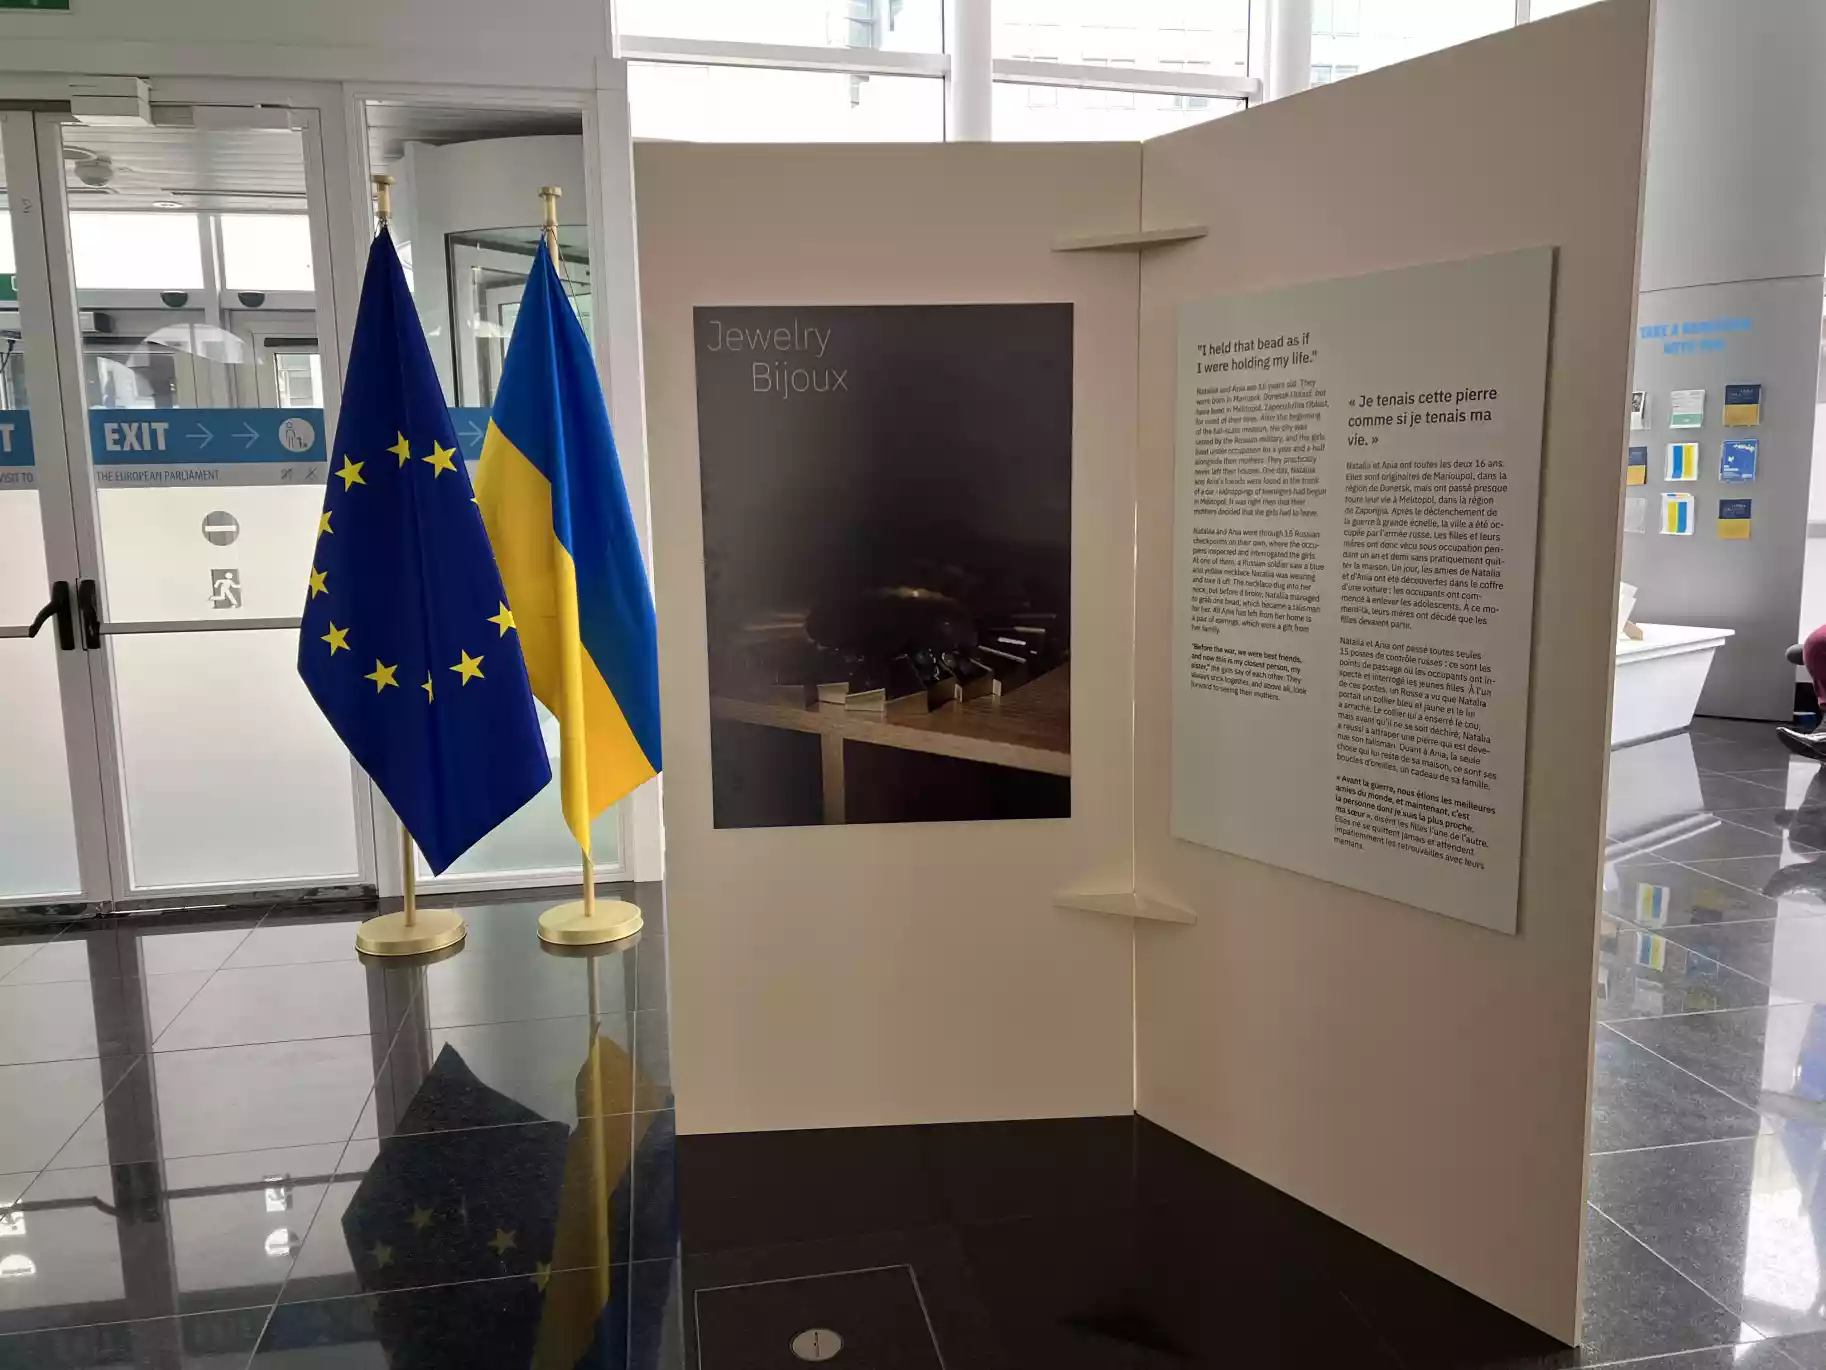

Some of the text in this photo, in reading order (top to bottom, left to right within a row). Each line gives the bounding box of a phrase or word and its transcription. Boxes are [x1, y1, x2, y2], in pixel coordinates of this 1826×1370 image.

[707, 318, 831, 358] Jewelry
[1197, 331, 1309, 356] "I held that bead as if
[1197, 349, 1317, 373] I were holding my life."
[752, 361, 849, 400] Bijoux
[1359, 392, 1373, 407] Je
[1377, 389, 1414, 406] tenais
[1418, 387, 1451, 404] cette
[1456, 384, 1497, 405] pierre
[1348, 406, 1491, 427] comme si je tenais ma
[103, 422, 169, 451] EXIT
[1347, 431, 1368, 446] vie.
[1413, 460, 1437, 468] toutes
[1453, 459, 1472, 468] deux
[97, 470, 220, 483] THE EUROPEAN PARLIAMENT
[1477, 471, 1496, 479] dans
[1473, 485, 1507, 493] presque
[1438, 496, 1457, 504] dans
[1479, 532, 1500, 540] leurs
[1438, 543, 1482, 553] occupation
[1471, 568, 1500, 577] Natalia
[1449, 578, 1503, 589] dans coffre
[1405, 587, 1444, 599] occupants
[1371, 607, 1389, 616] leurs
[1456, 649, 1481, 659] seules
[1385, 652, 1416, 663] contrôle
[1417, 657, 1442, 666] russes
[1460, 661, 1476, 670] sont
[1339, 658, 1360, 669] points
[1427, 669, 1467, 682] occupants
[1459, 753, 1480, 764] seule
[1464, 766, 1481, 776] sont
[1397, 787, 1414, 796] nous
[1454, 797, 1495, 813] meilleures
[1343, 797, 1374, 811] personne
[1427, 814, 1443, 826] plus
